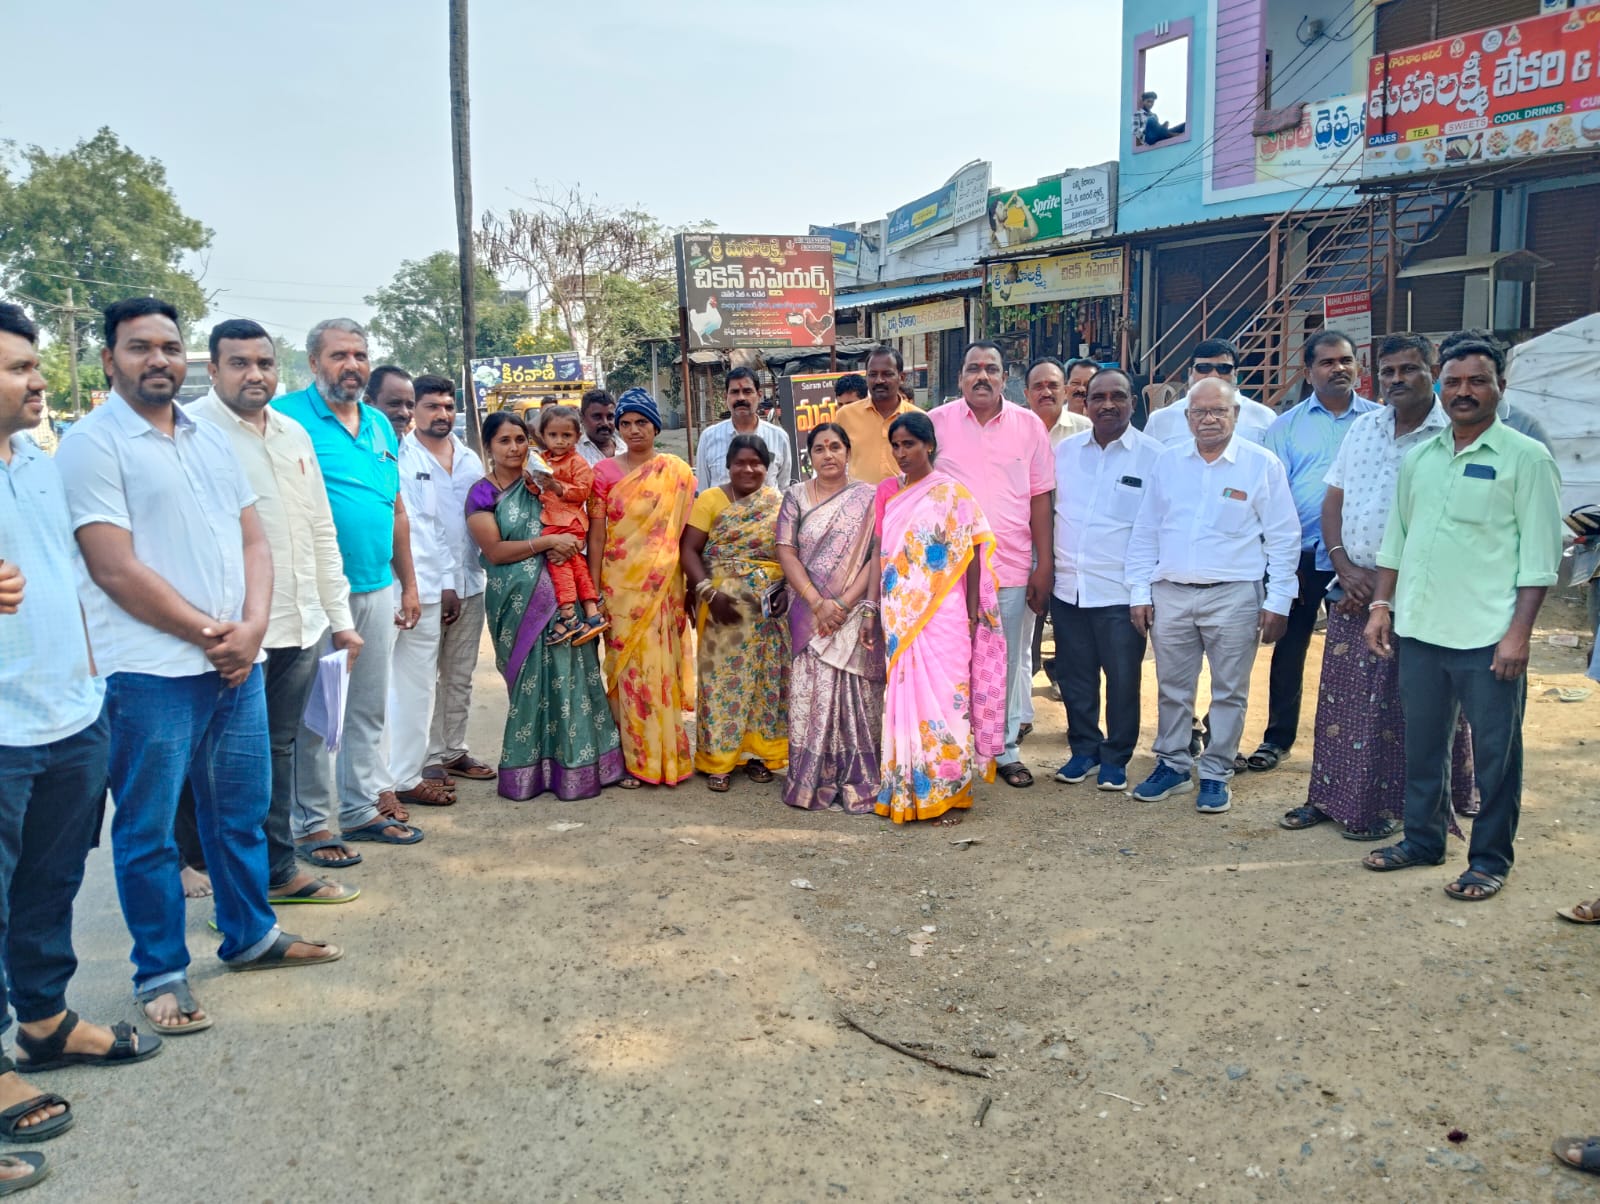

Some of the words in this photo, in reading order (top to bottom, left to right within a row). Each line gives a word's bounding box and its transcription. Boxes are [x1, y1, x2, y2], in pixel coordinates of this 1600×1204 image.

[1494, 111, 1522, 125] COOL
[1524, 103, 1564, 119] DRINKS
[1412, 129, 1430, 139] TEA
[1448, 118, 1487, 132] SWEETS
[1368, 133, 1397, 146] CAKES
[1032, 195, 1061, 217] Sprite
[709, 235, 724, 262] శ్రీ
[693, 264, 745, 289] చికెన్
[801, 382, 822, 391] Sairam
